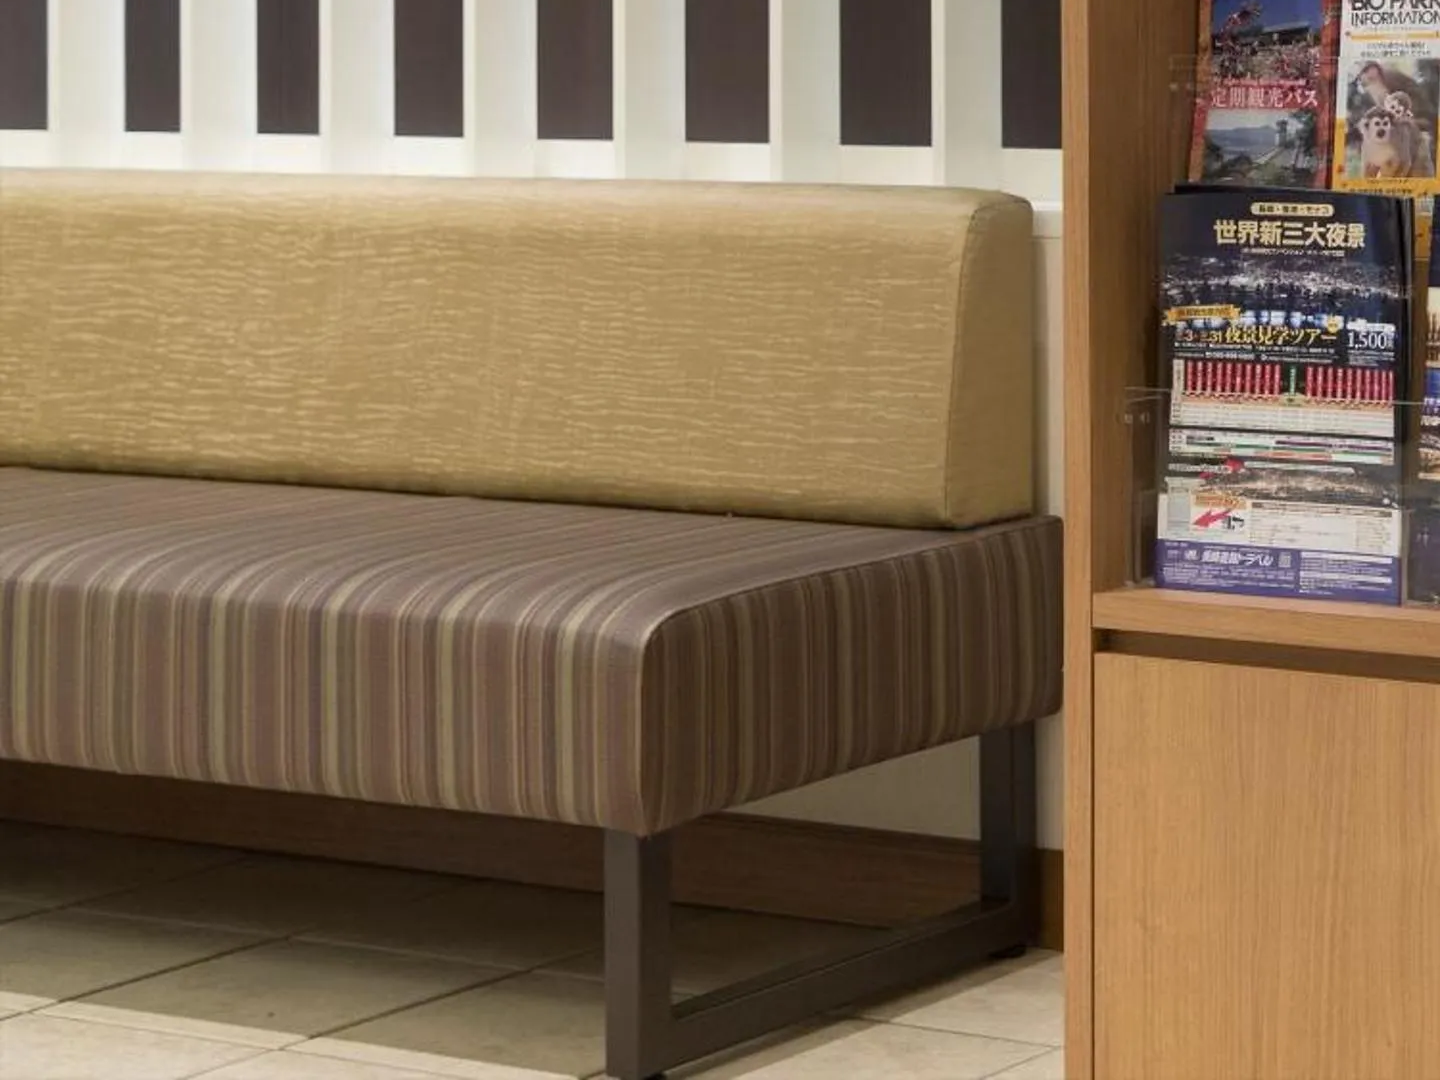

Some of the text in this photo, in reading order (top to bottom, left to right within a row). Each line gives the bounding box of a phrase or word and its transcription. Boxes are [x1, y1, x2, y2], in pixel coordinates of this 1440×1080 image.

[1210, 85, 1319, 108] 定期観光バス
[1213, 219, 1366, 248] 世界新三大夜景
